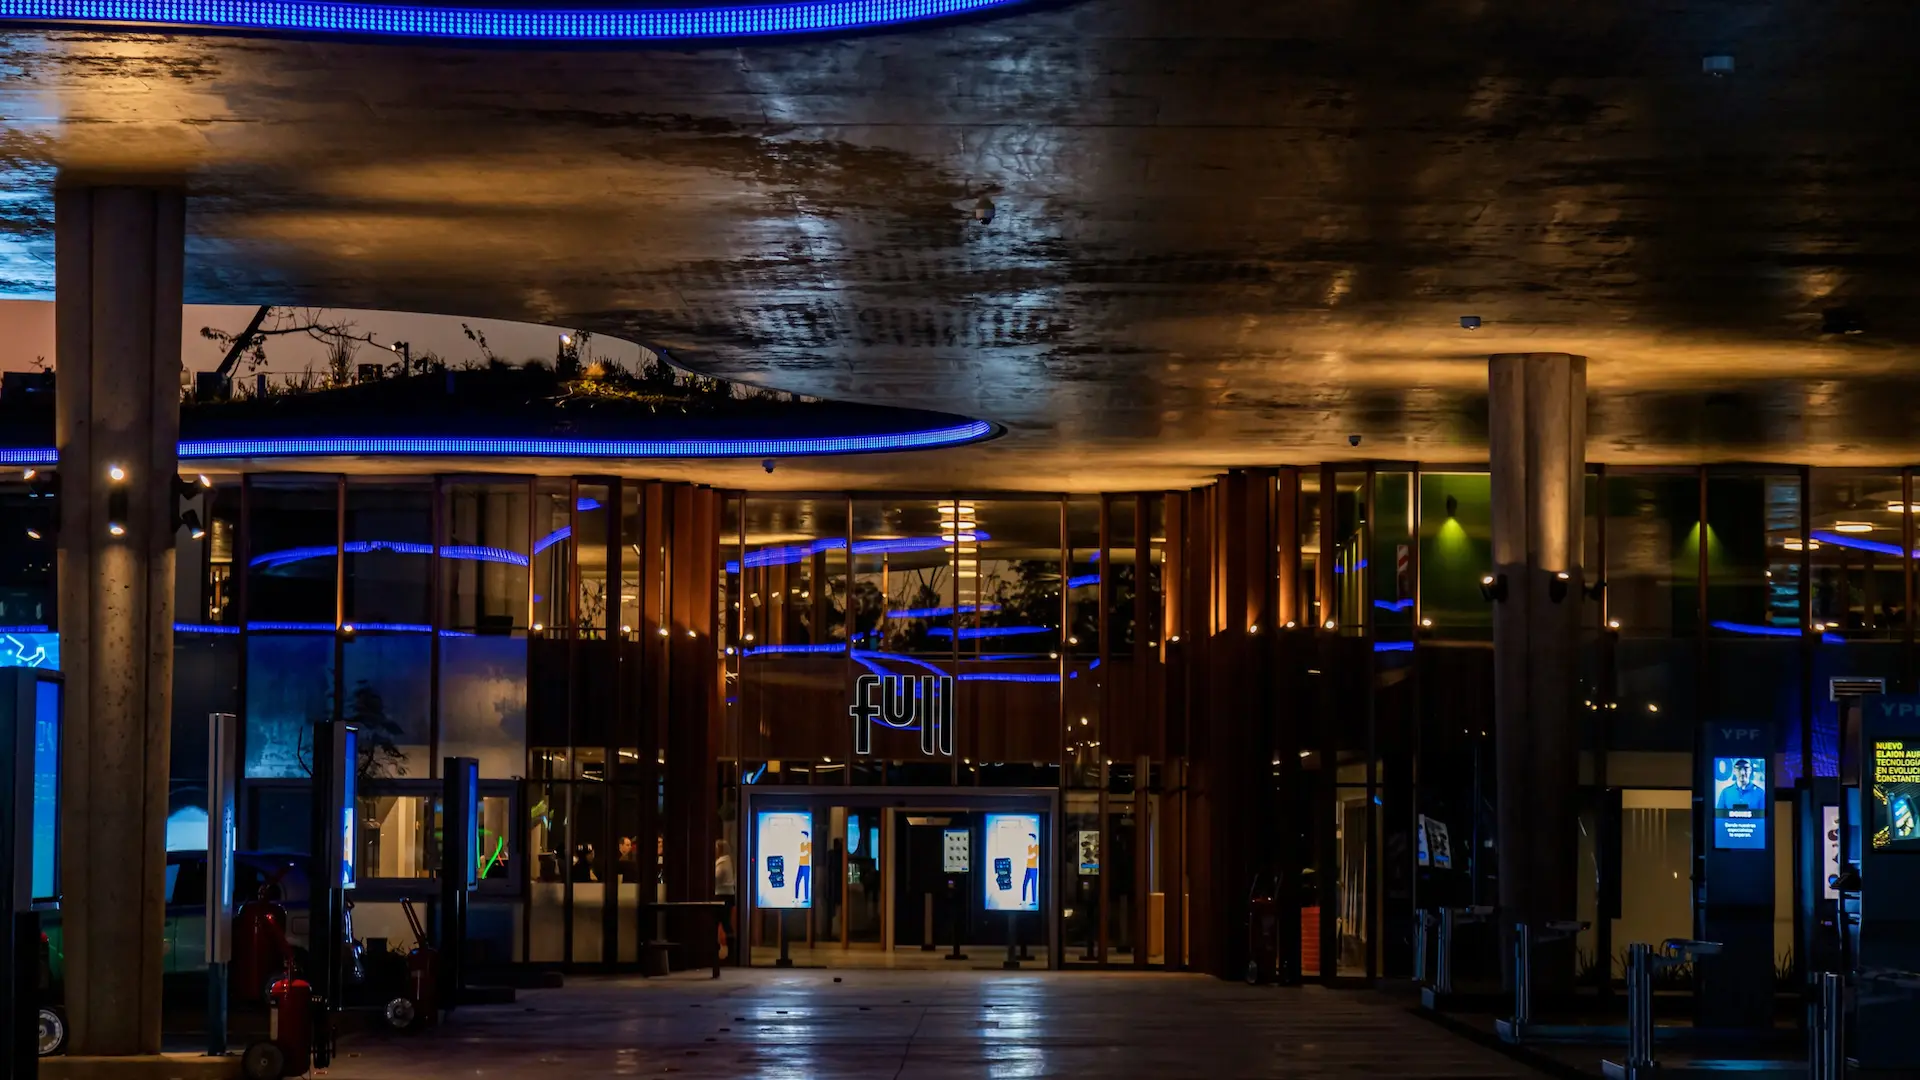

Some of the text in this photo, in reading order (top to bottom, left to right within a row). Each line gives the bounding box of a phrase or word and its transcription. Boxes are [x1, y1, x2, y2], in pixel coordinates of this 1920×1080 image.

[850, 675, 953, 755] full
[1720, 728, 1761, 740] YPF
[1876, 742, 1903, 750] NUEVO
[1876, 750, 1904, 758] ELAION
